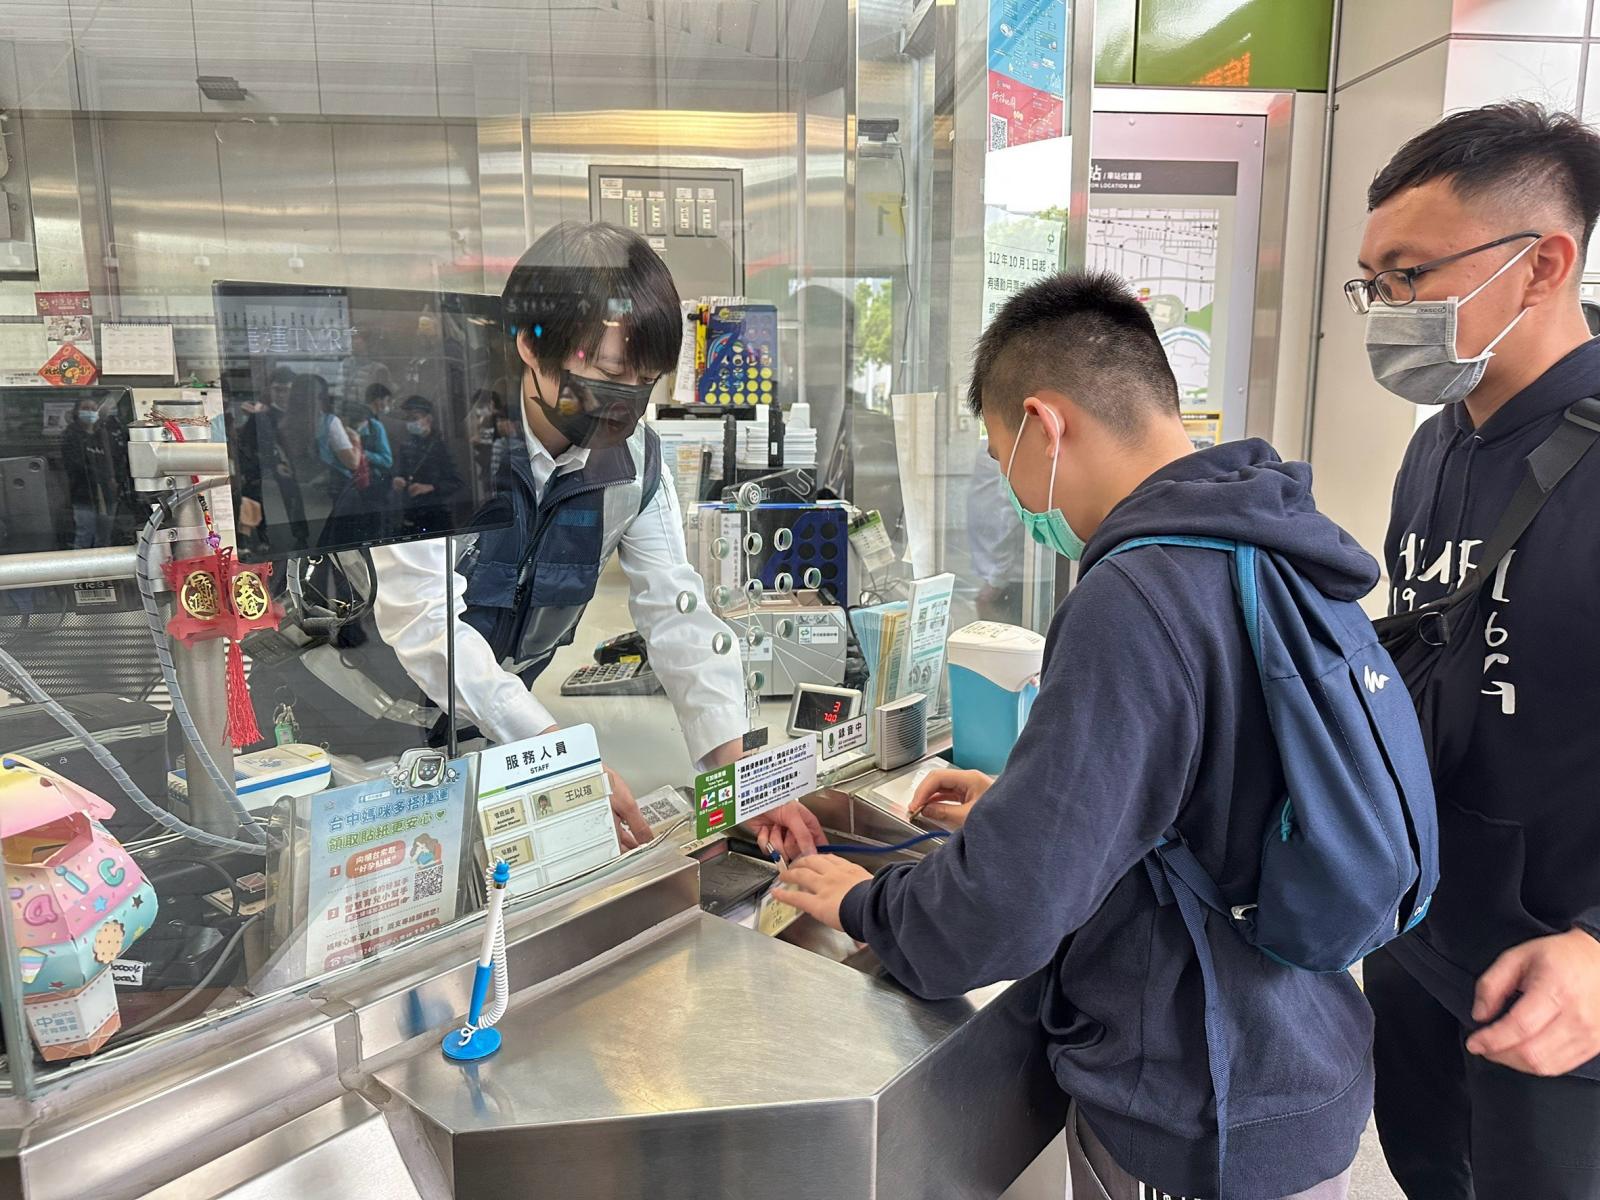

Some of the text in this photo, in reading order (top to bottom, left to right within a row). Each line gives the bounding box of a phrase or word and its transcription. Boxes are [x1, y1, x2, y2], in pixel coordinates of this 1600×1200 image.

[833, 701, 841, 713] 3
[838, 721, 862, 739] 錄音中
[506, 741, 568, 771] 服務人員
[530, 763, 550, 775] STAFF
[328, 787, 450, 833] 台中媽咪多搭捷運
[327, 811, 433, 853] 領取貼紙更安心
